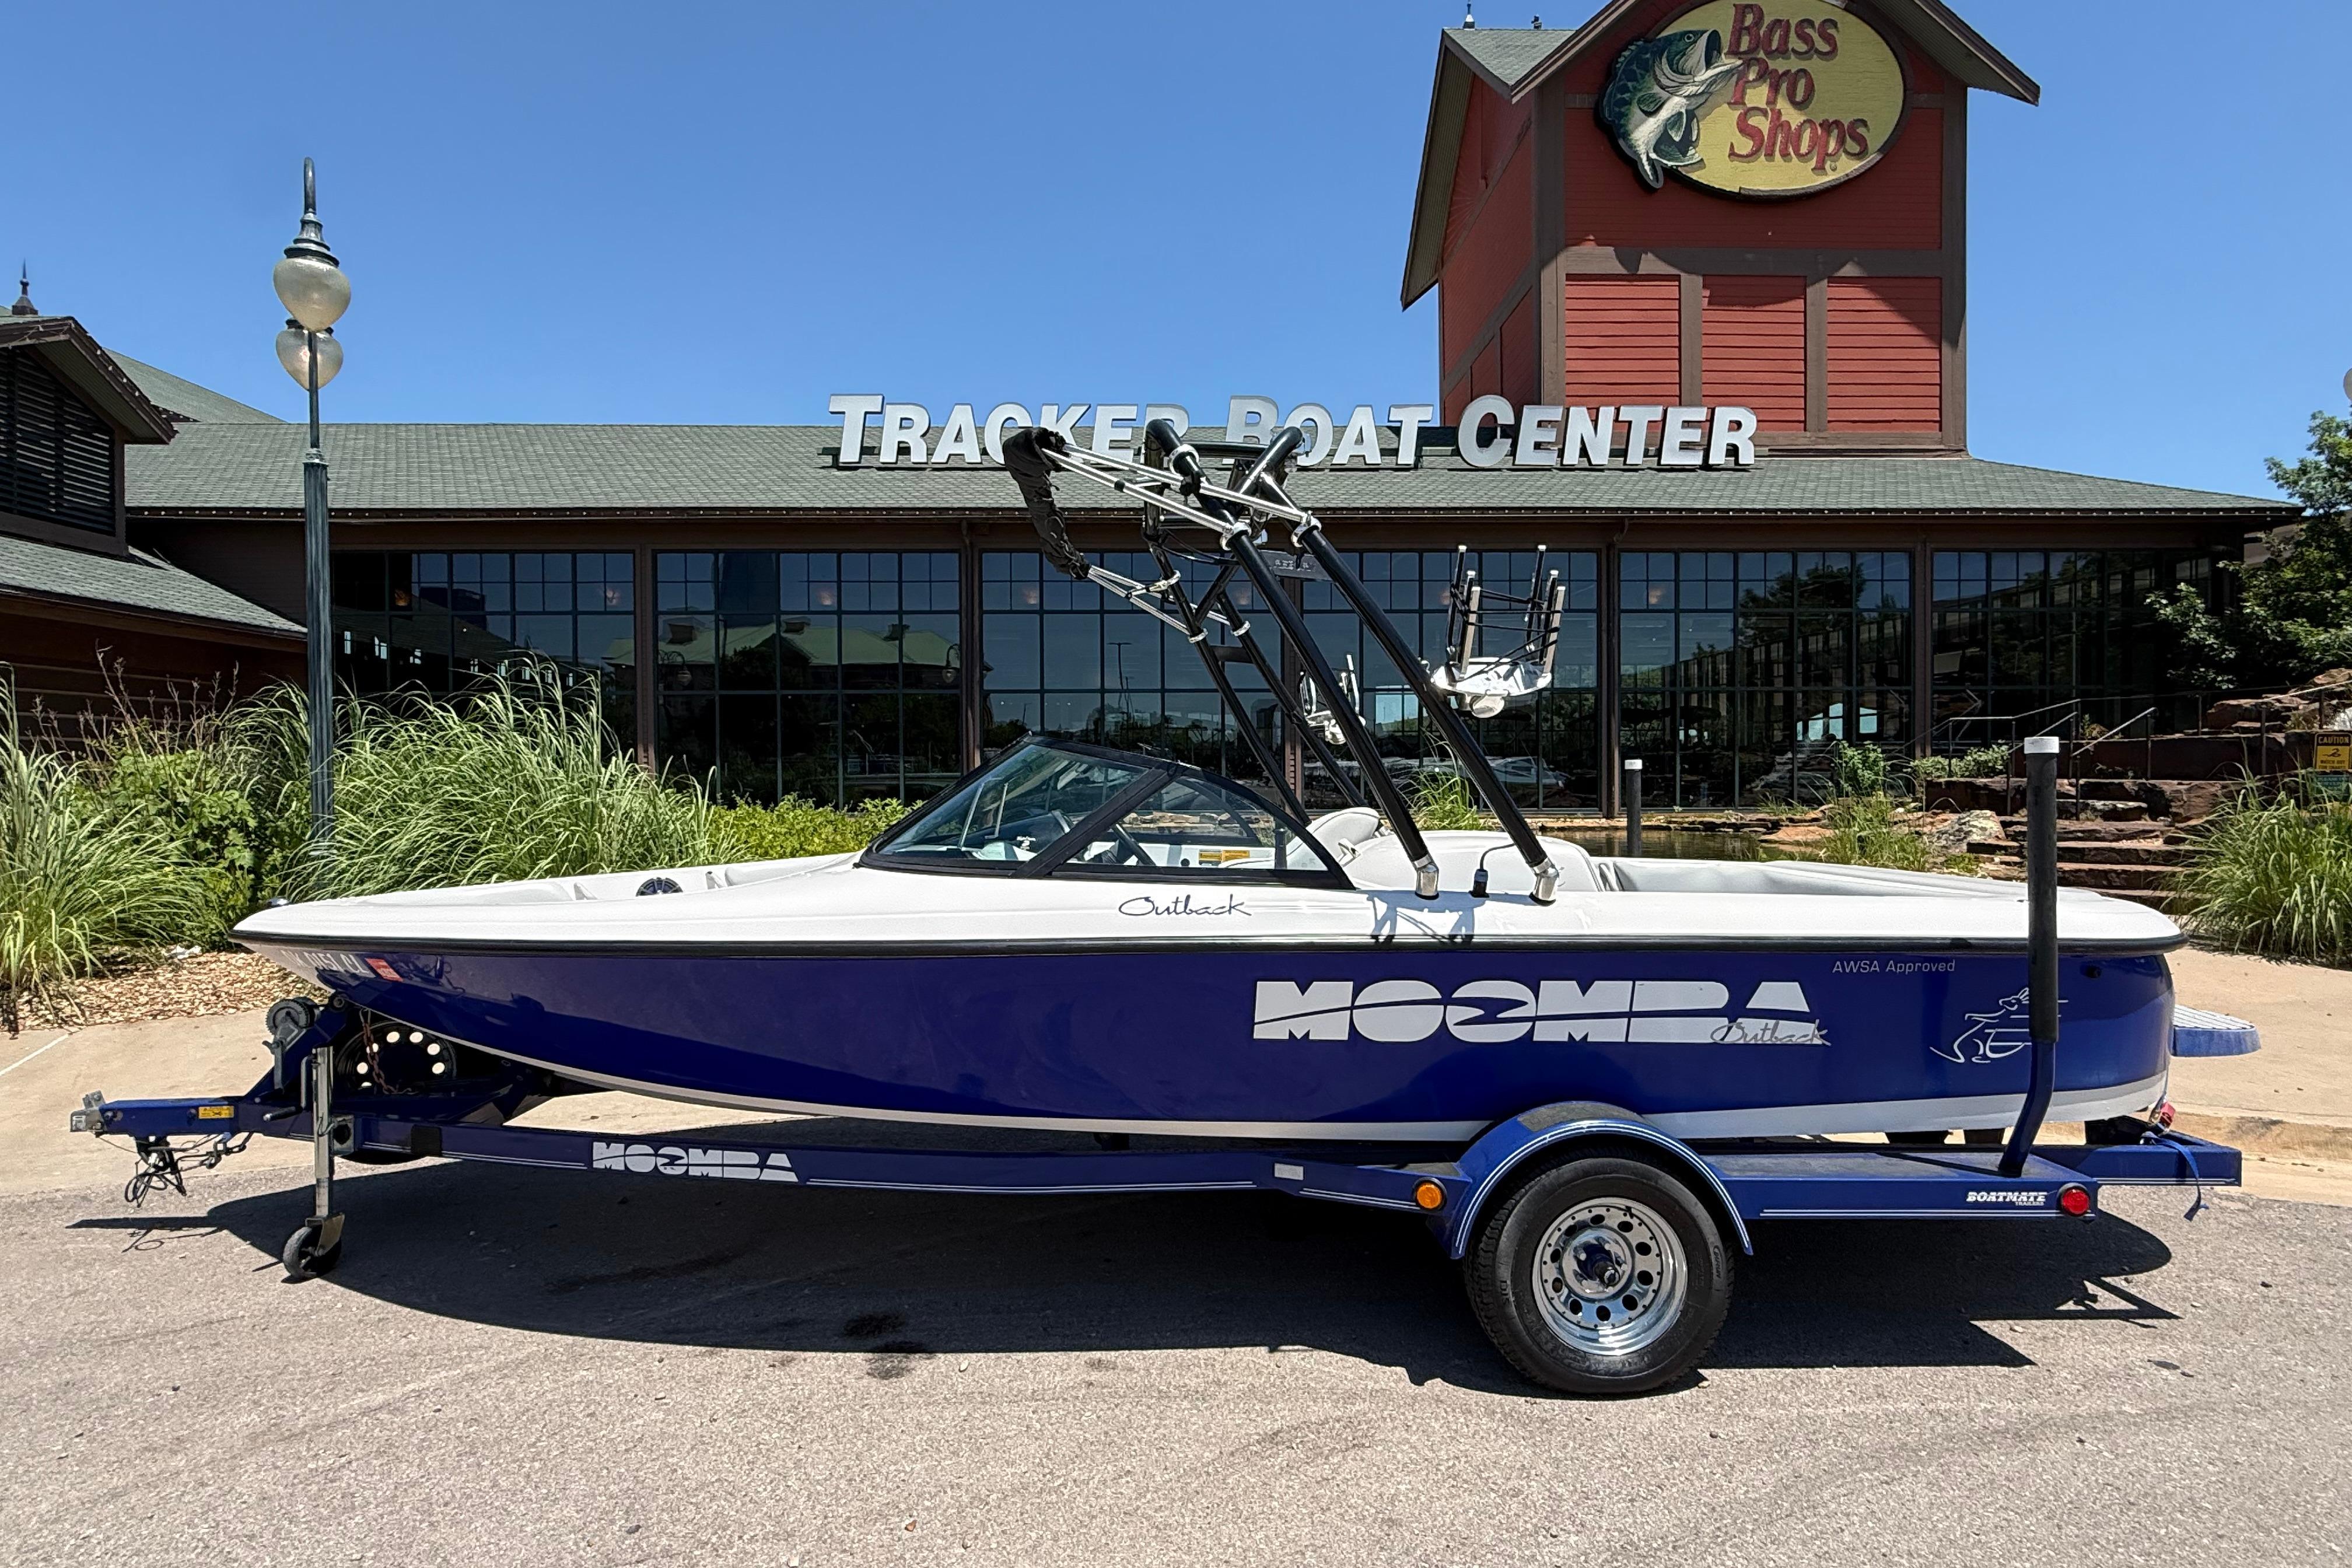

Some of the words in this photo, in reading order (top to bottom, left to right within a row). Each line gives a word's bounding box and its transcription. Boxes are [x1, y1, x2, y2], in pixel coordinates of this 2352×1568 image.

[1725, 3, 1839, 59] Bass
[1727, 58, 1815, 110] Pro
[1728, 106, 1871, 174] Shops
[1222, 395, 1434, 467] BOAT
[1457, 394, 1757, 467] CENTER
[1118, 894, 1252, 916] Outback
[1832, 960, 1880, 974] AWSA
[1885, 959, 1955, 975] Approved
[1253, 980, 1823, 1044] MOOMBA
[1710, 1019, 1832, 1046] Outback
[592, 1142, 799, 1183] MOOMBA
[1966, 1191, 2048, 1202] BOATMATE
